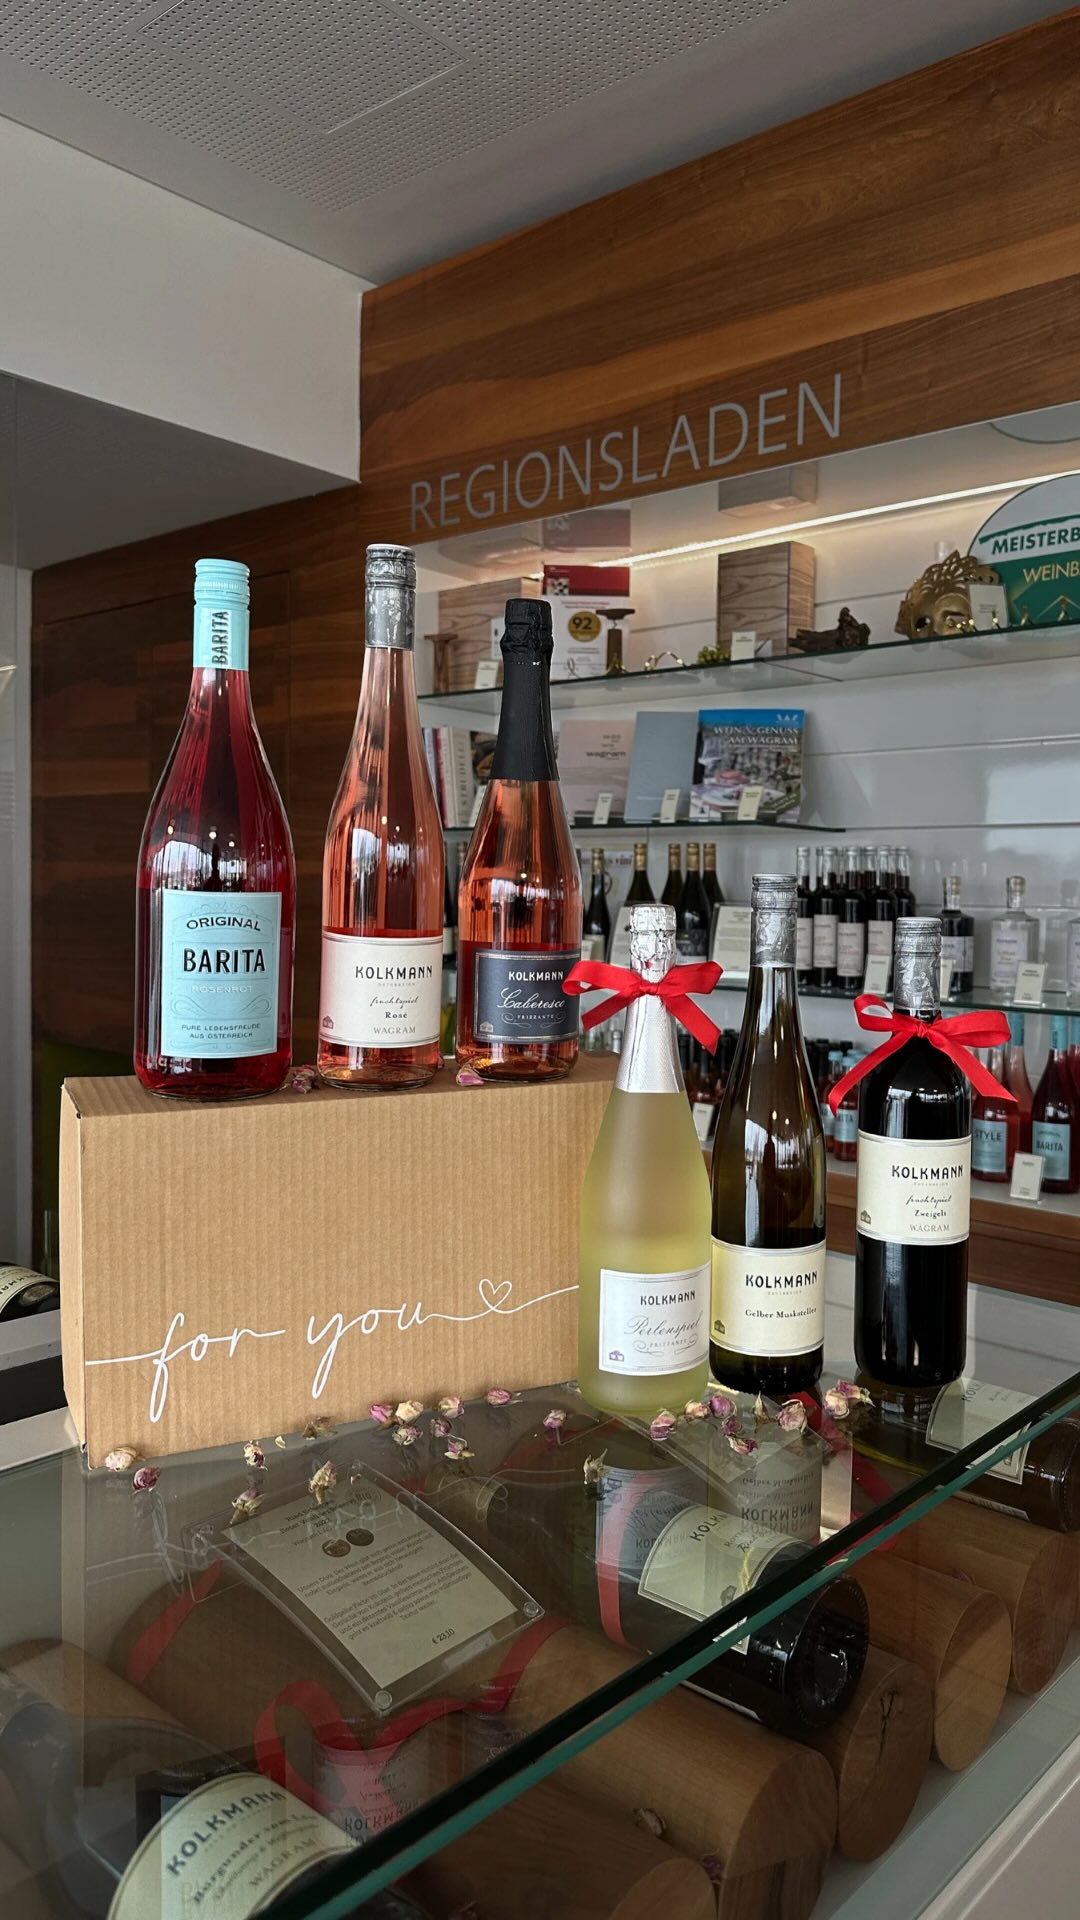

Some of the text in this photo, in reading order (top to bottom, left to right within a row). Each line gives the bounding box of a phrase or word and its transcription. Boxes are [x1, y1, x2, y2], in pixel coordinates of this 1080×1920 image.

[411, 373, 842, 533] REGIONSLADEN
[572, 617, 593, 631] 92
[211, 611, 229, 666] BARITA
[186, 916, 261, 932] ORIGINAL
[183, 947, 266, 974] BARITA
[355, 965, 433, 980] KOLKMANN
[508, 971, 564, 982] KOLKMANN
[385, 1011, 408, 1019] Rosé
[373, 1026, 417, 1035] WAGRAM
[974, 1128, 1002, 1143] STYLE
[1036, 1140, 1063, 1152] BARITA
[891, 1164, 964, 1180] KOLKMANN
[914, 1209, 947, 1219] Zweigelt
[909, 1223, 950, 1233] WAGRAM
[745, 1270, 818, 1288] KOLKMANN
[640, 1290, 696, 1306] KOLKMANN
[745, 1306, 817, 1319] Gelber Muskateller
[623, 1310, 704, 1339] Perlenspiel
[120, 1301, 428, 1423] for you
[167, 1790, 288, 1876] KOLKMANN
